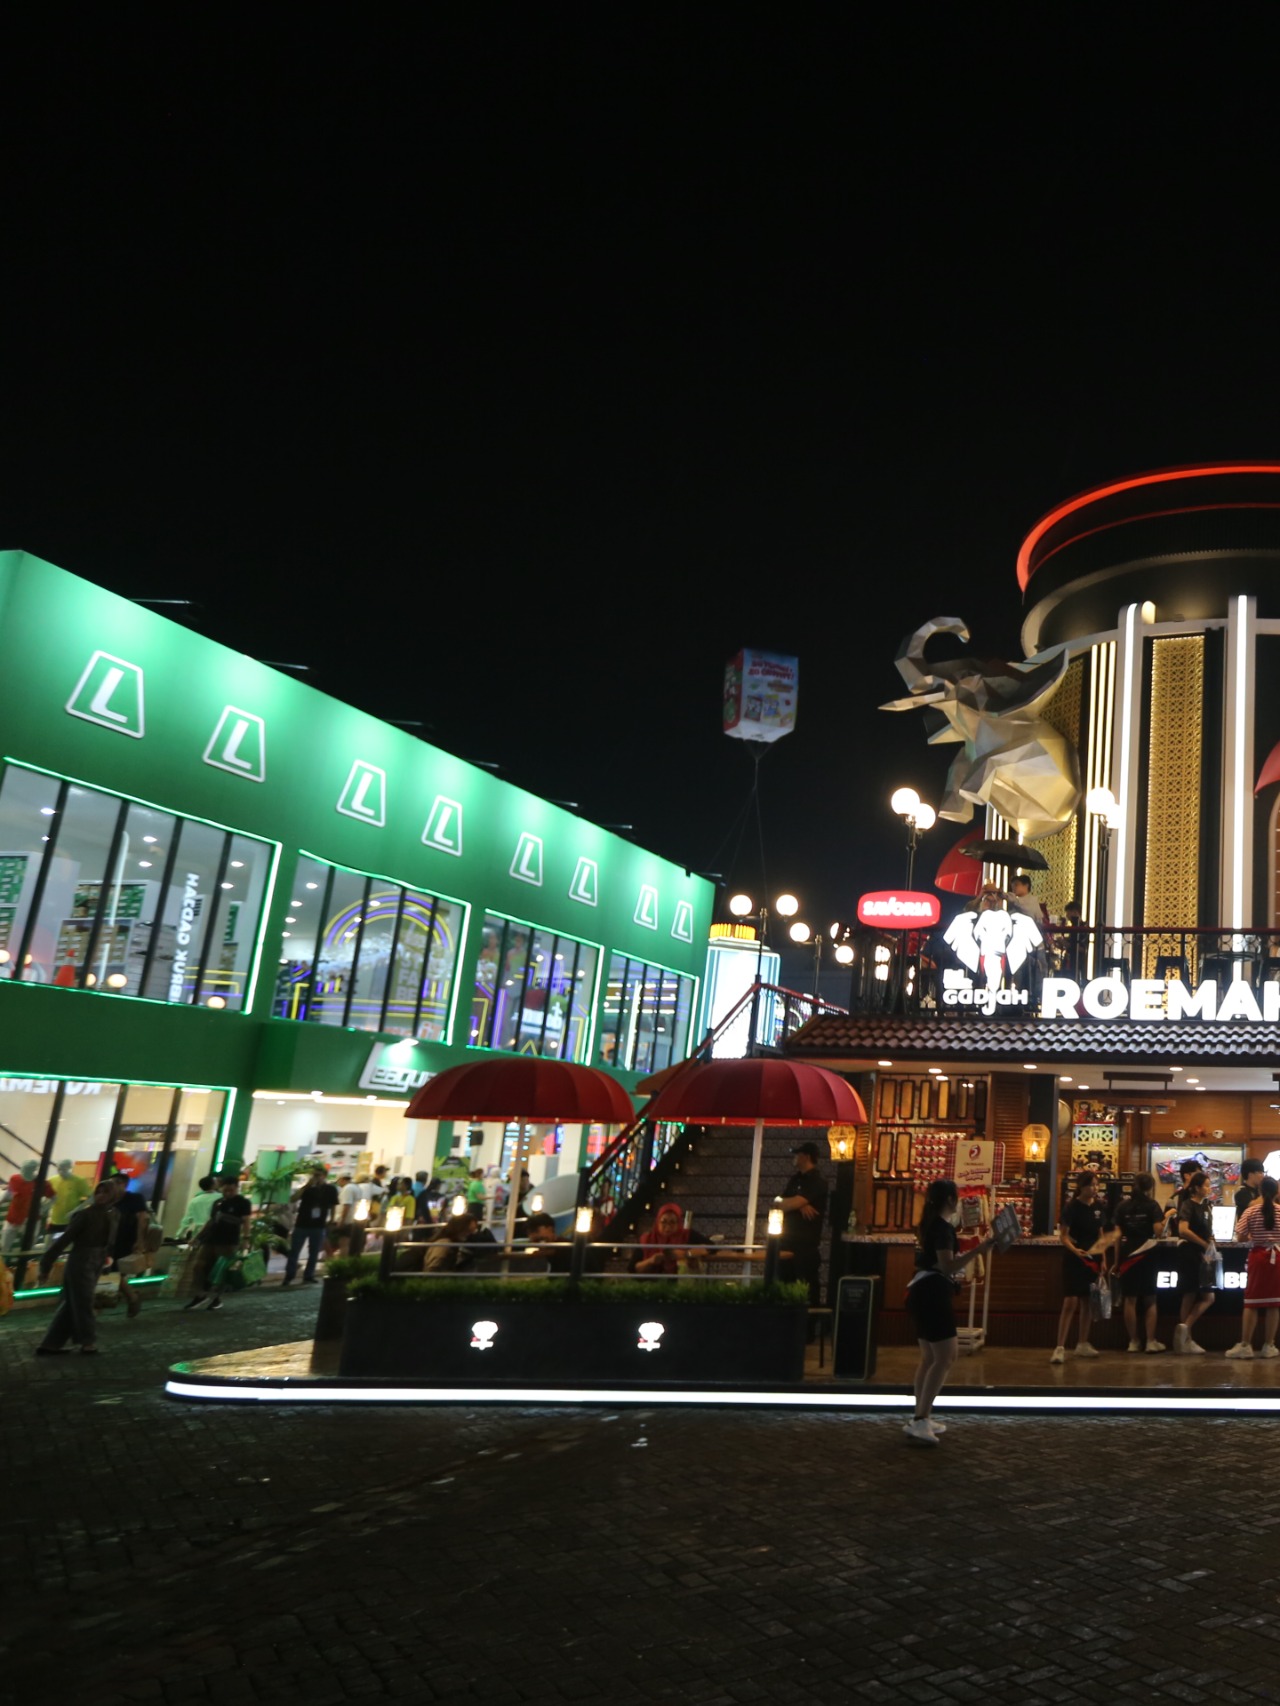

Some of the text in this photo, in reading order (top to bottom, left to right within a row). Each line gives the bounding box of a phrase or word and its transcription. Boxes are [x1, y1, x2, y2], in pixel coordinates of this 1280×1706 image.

[89, 666, 128, 724] L
[222, 719, 252, 770] L
[351, 771, 375, 816] L
[434, 806, 453, 847] L
[520, 842, 535, 878] L
[578, 865, 592, 899] L
[641, 892, 653, 923] L
[677, 907, 689, 936] L
